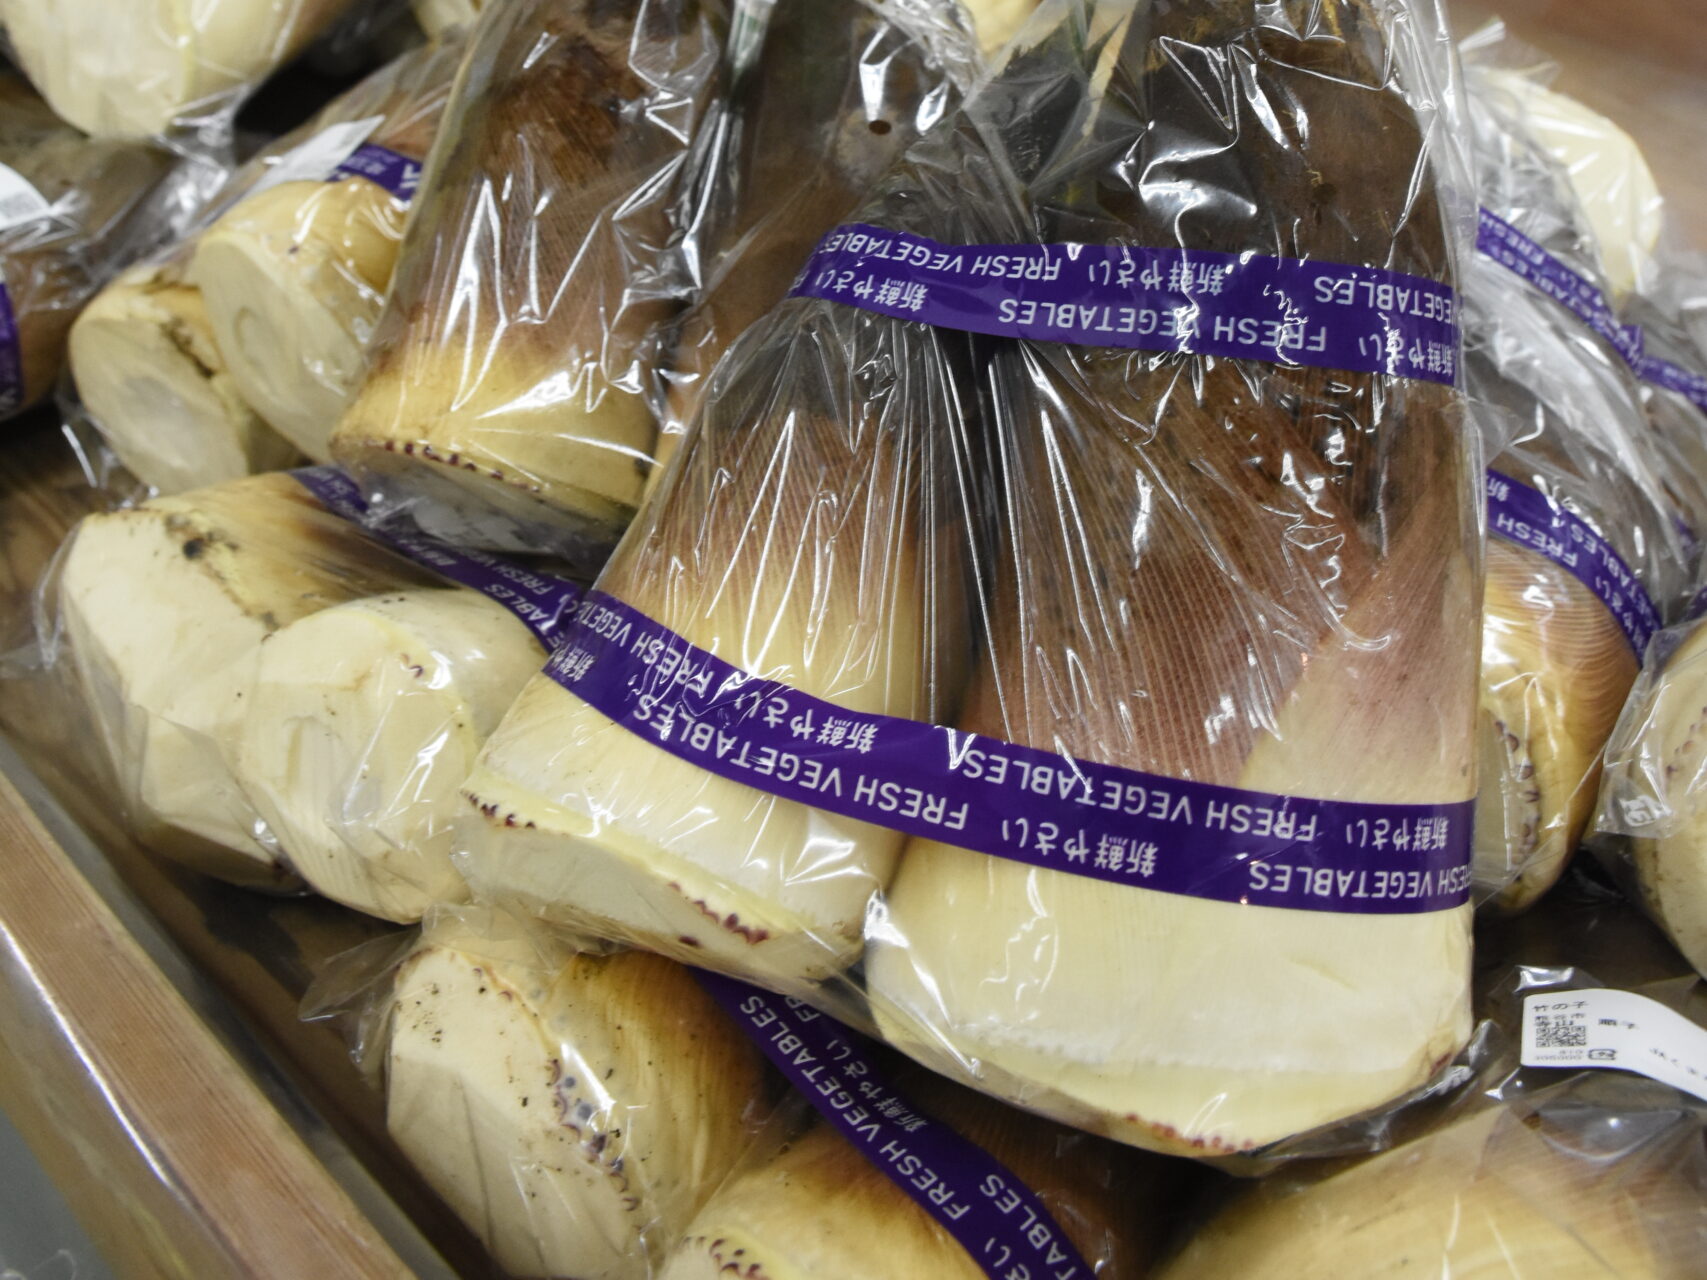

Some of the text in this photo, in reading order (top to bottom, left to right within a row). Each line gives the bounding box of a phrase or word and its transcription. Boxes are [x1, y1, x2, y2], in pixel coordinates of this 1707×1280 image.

[815, 269, 929, 312] 新鮮やさい
[970, 255, 1062, 281] FRESH
[1088, 259, 1227, 296] 新鮮やさい
[997, 298, 1328, 352] FRESH VEGETABLES
[1313, 275, 1453, 324] EGETABLES
[1497, 512, 1579, 567] FRESH
[494, 565, 554, 596] FRESH
[629, 631, 715, 699] FRESH
[734, 687, 879, 754] 新鮮やさい
[633, 693, 969, 830] FRESH VEGETABLES
[962, 748, 1318, 842] FRESH VEGETABLES
[1002, 817, 1159, 878] 新鮮やさい
[1346, 816, 1449, 851] 新鮮やさい
[1249, 861, 1433, 899] VEGETABLES
[739, 995, 971, 1221] FRESH VEGETABLES
[826, 1039, 929, 1135] 新鮮やさい
